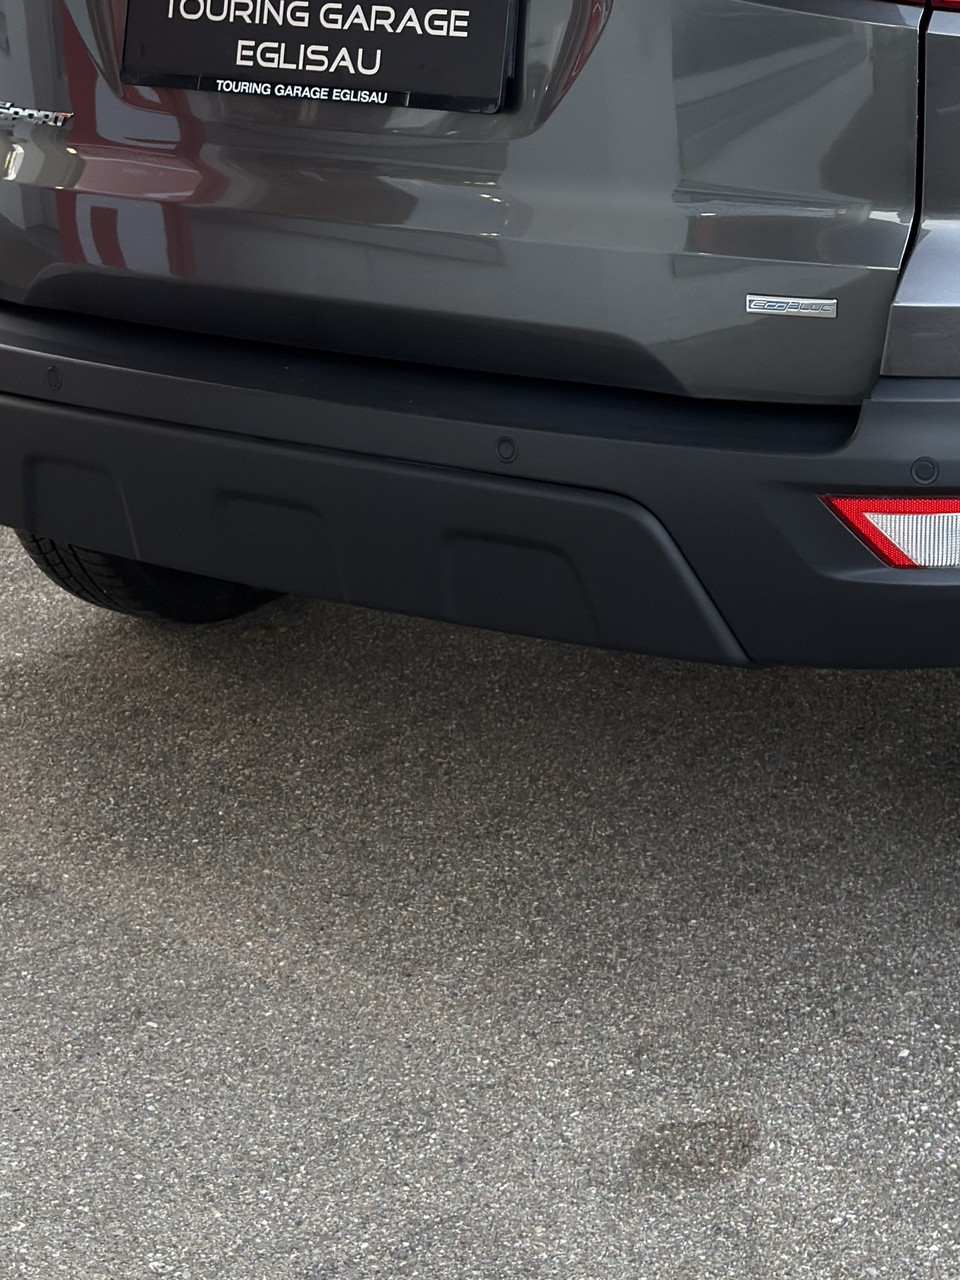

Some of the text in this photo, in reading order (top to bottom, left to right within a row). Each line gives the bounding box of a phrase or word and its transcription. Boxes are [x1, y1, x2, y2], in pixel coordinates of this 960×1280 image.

[319, 2, 470, 38] GARAGE
[235, 39, 382, 76] EGLISAU
[216, 79, 388, 104] TOURING GARAGE EGLISAU
